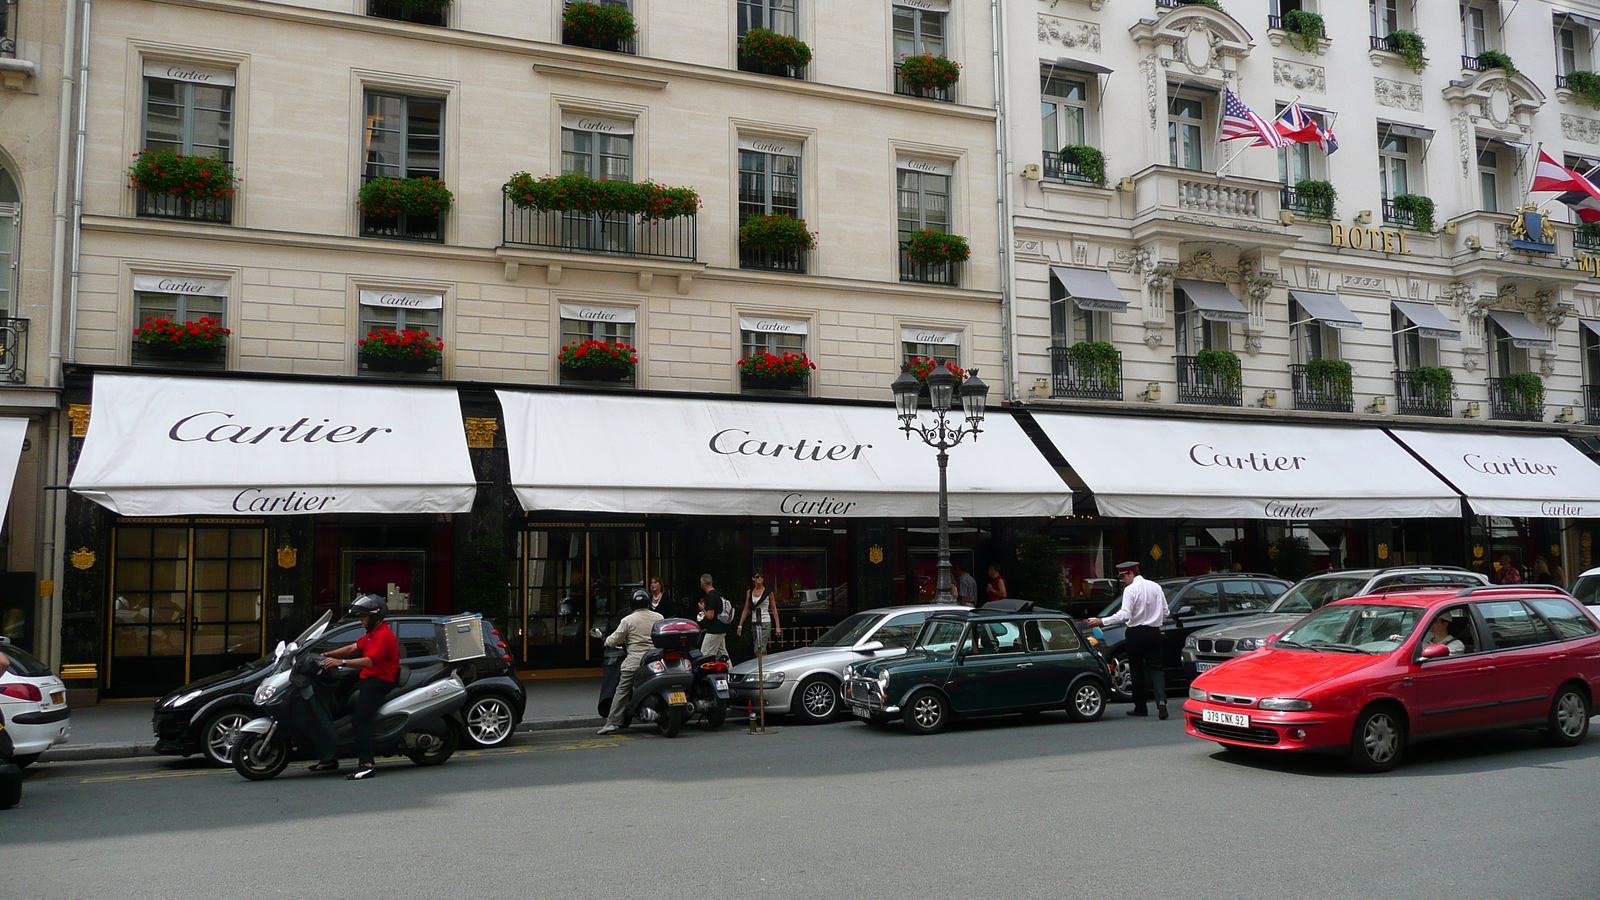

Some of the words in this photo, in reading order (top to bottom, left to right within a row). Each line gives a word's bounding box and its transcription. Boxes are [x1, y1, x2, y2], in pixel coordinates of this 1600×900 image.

[167, 67, 213, 82] Cartier
[577, 118, 615, 133] Cartier
[751, 140, 786, 153] Cartier
[908, 160, 936, 171] Cartier
[1331, 223, 1412, 255] HOTEL
[158, 279, 206, 293] Cartier
[380, 294, 423, 307] Cartier
[579, 306, 617, 321] Cartier
[756, 320, 791, 332] Cartier
[915, 331, 946, 342] Cartier
[169, 411, 393, 445] Cartier
[708, 428, 873, 462] Cartier
[1189, 443, 1306, 472] Cartier
[1463, 454, 1558, 476] Cartier
[232, 489, 335, 513] Cartier
[779, 493, 856, 516] Cartier
[1541, 500, 1583, 516] Cartier
[1264, 500, 1318, 518] Cartier
[1207, 711, 1219, 722] 379
[1220, 713, 1233, 725] CNK
[1235, 716, 1244, 726] 92
